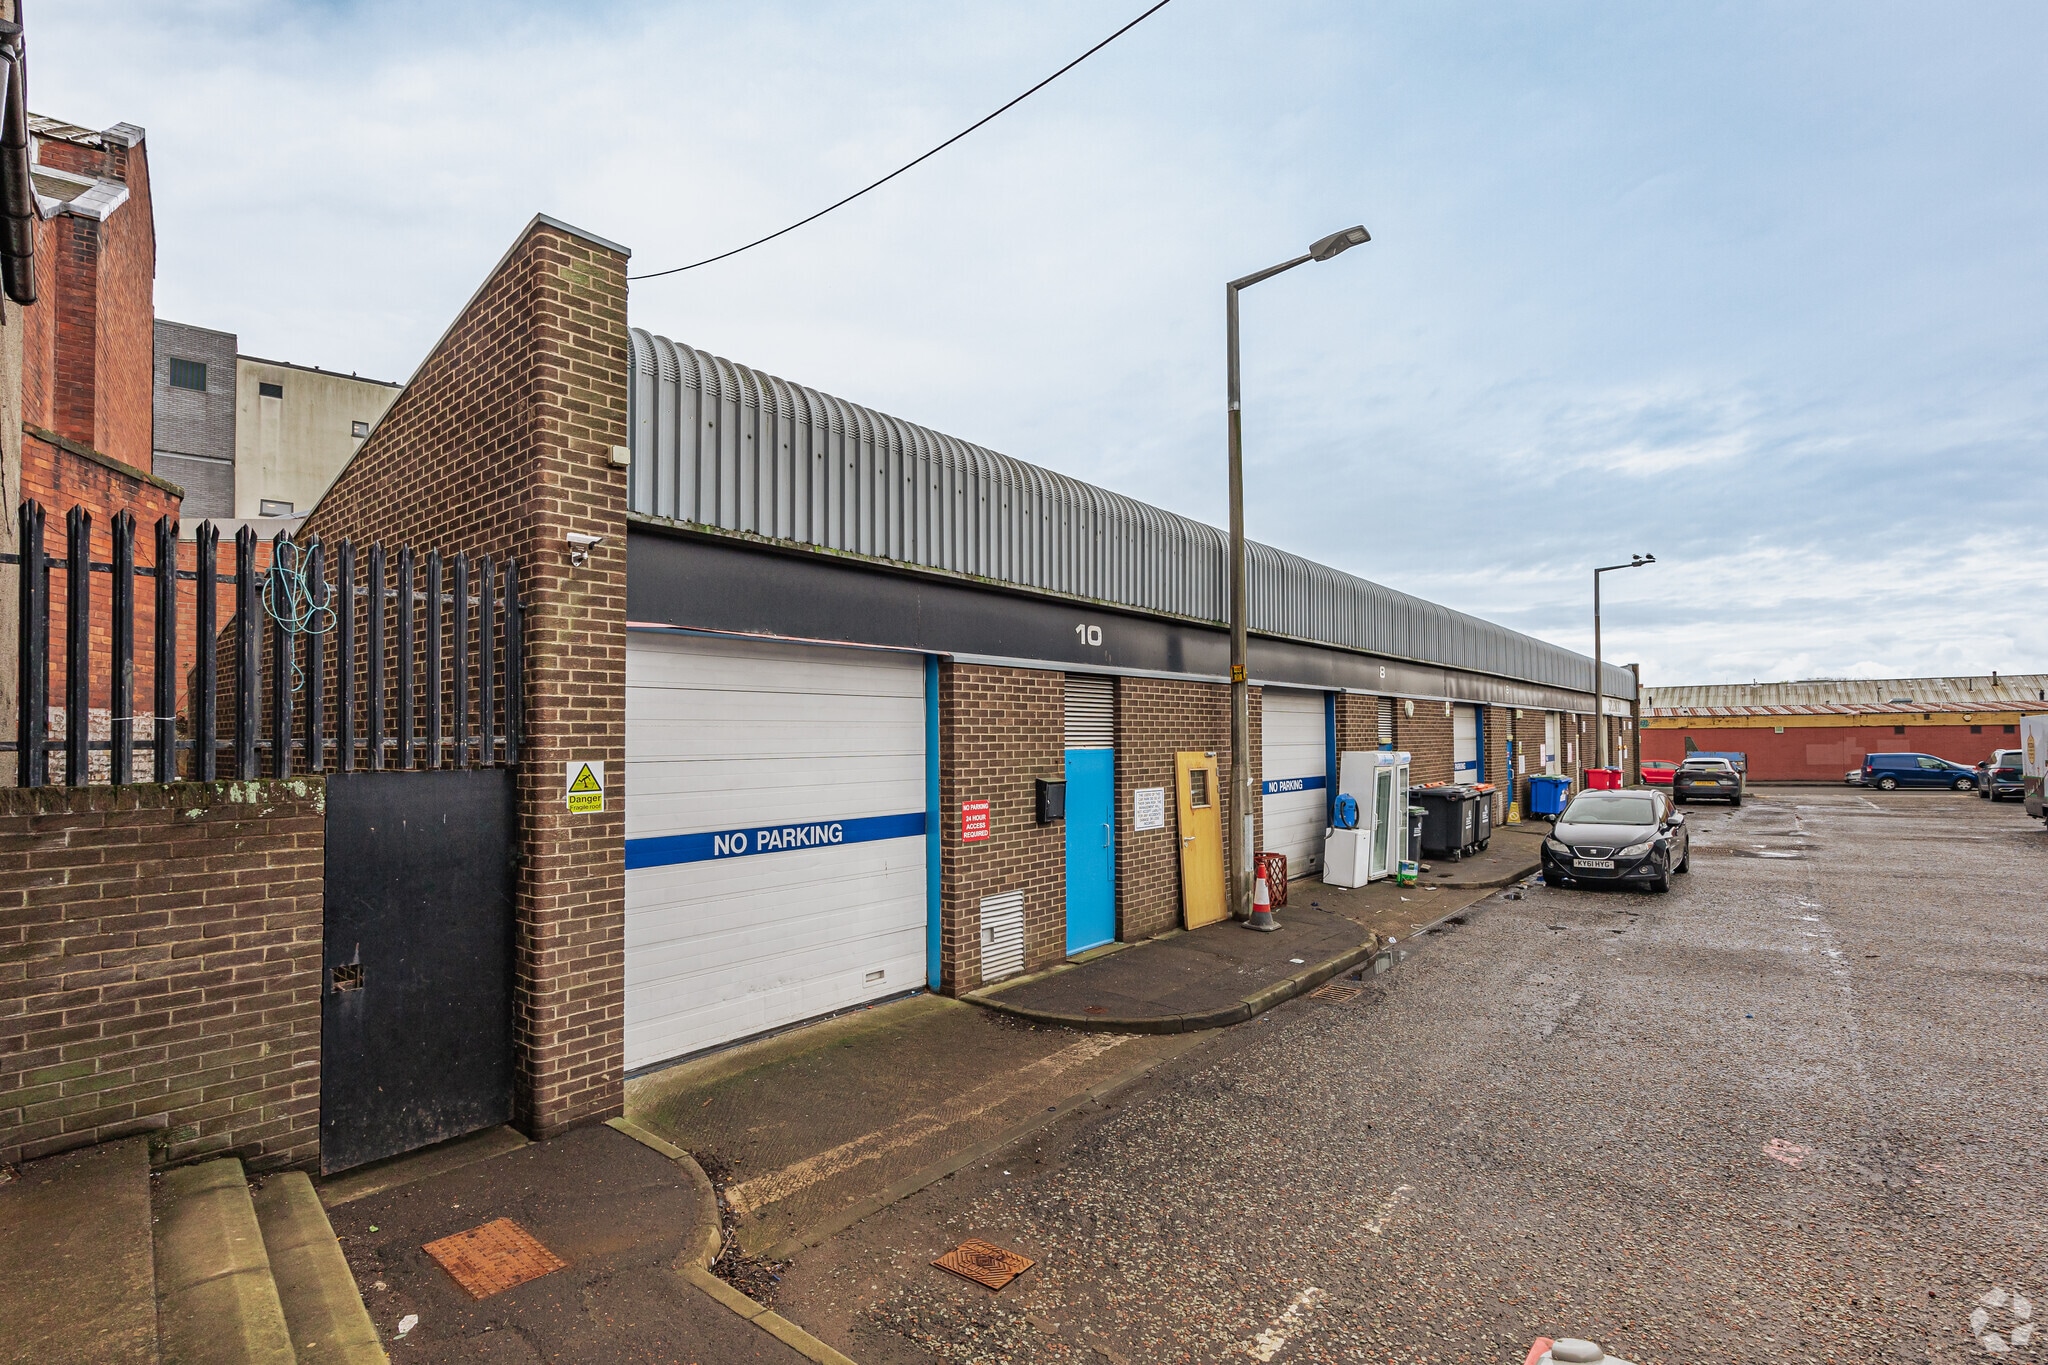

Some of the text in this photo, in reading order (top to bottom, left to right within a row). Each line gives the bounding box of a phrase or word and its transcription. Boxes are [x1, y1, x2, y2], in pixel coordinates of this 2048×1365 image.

[1075, 624, 1102, 646] 10
[1379, 665, 1386, 679] 8
[1268, 779, 1303, 793] NO PARKING
[569, 795, 602, 805] Danger
[966, 822, 986, 830] ACCESS
[714, 823, 843, 856] NO PARKING
[963, 830, 989, 839] REQUIRED
